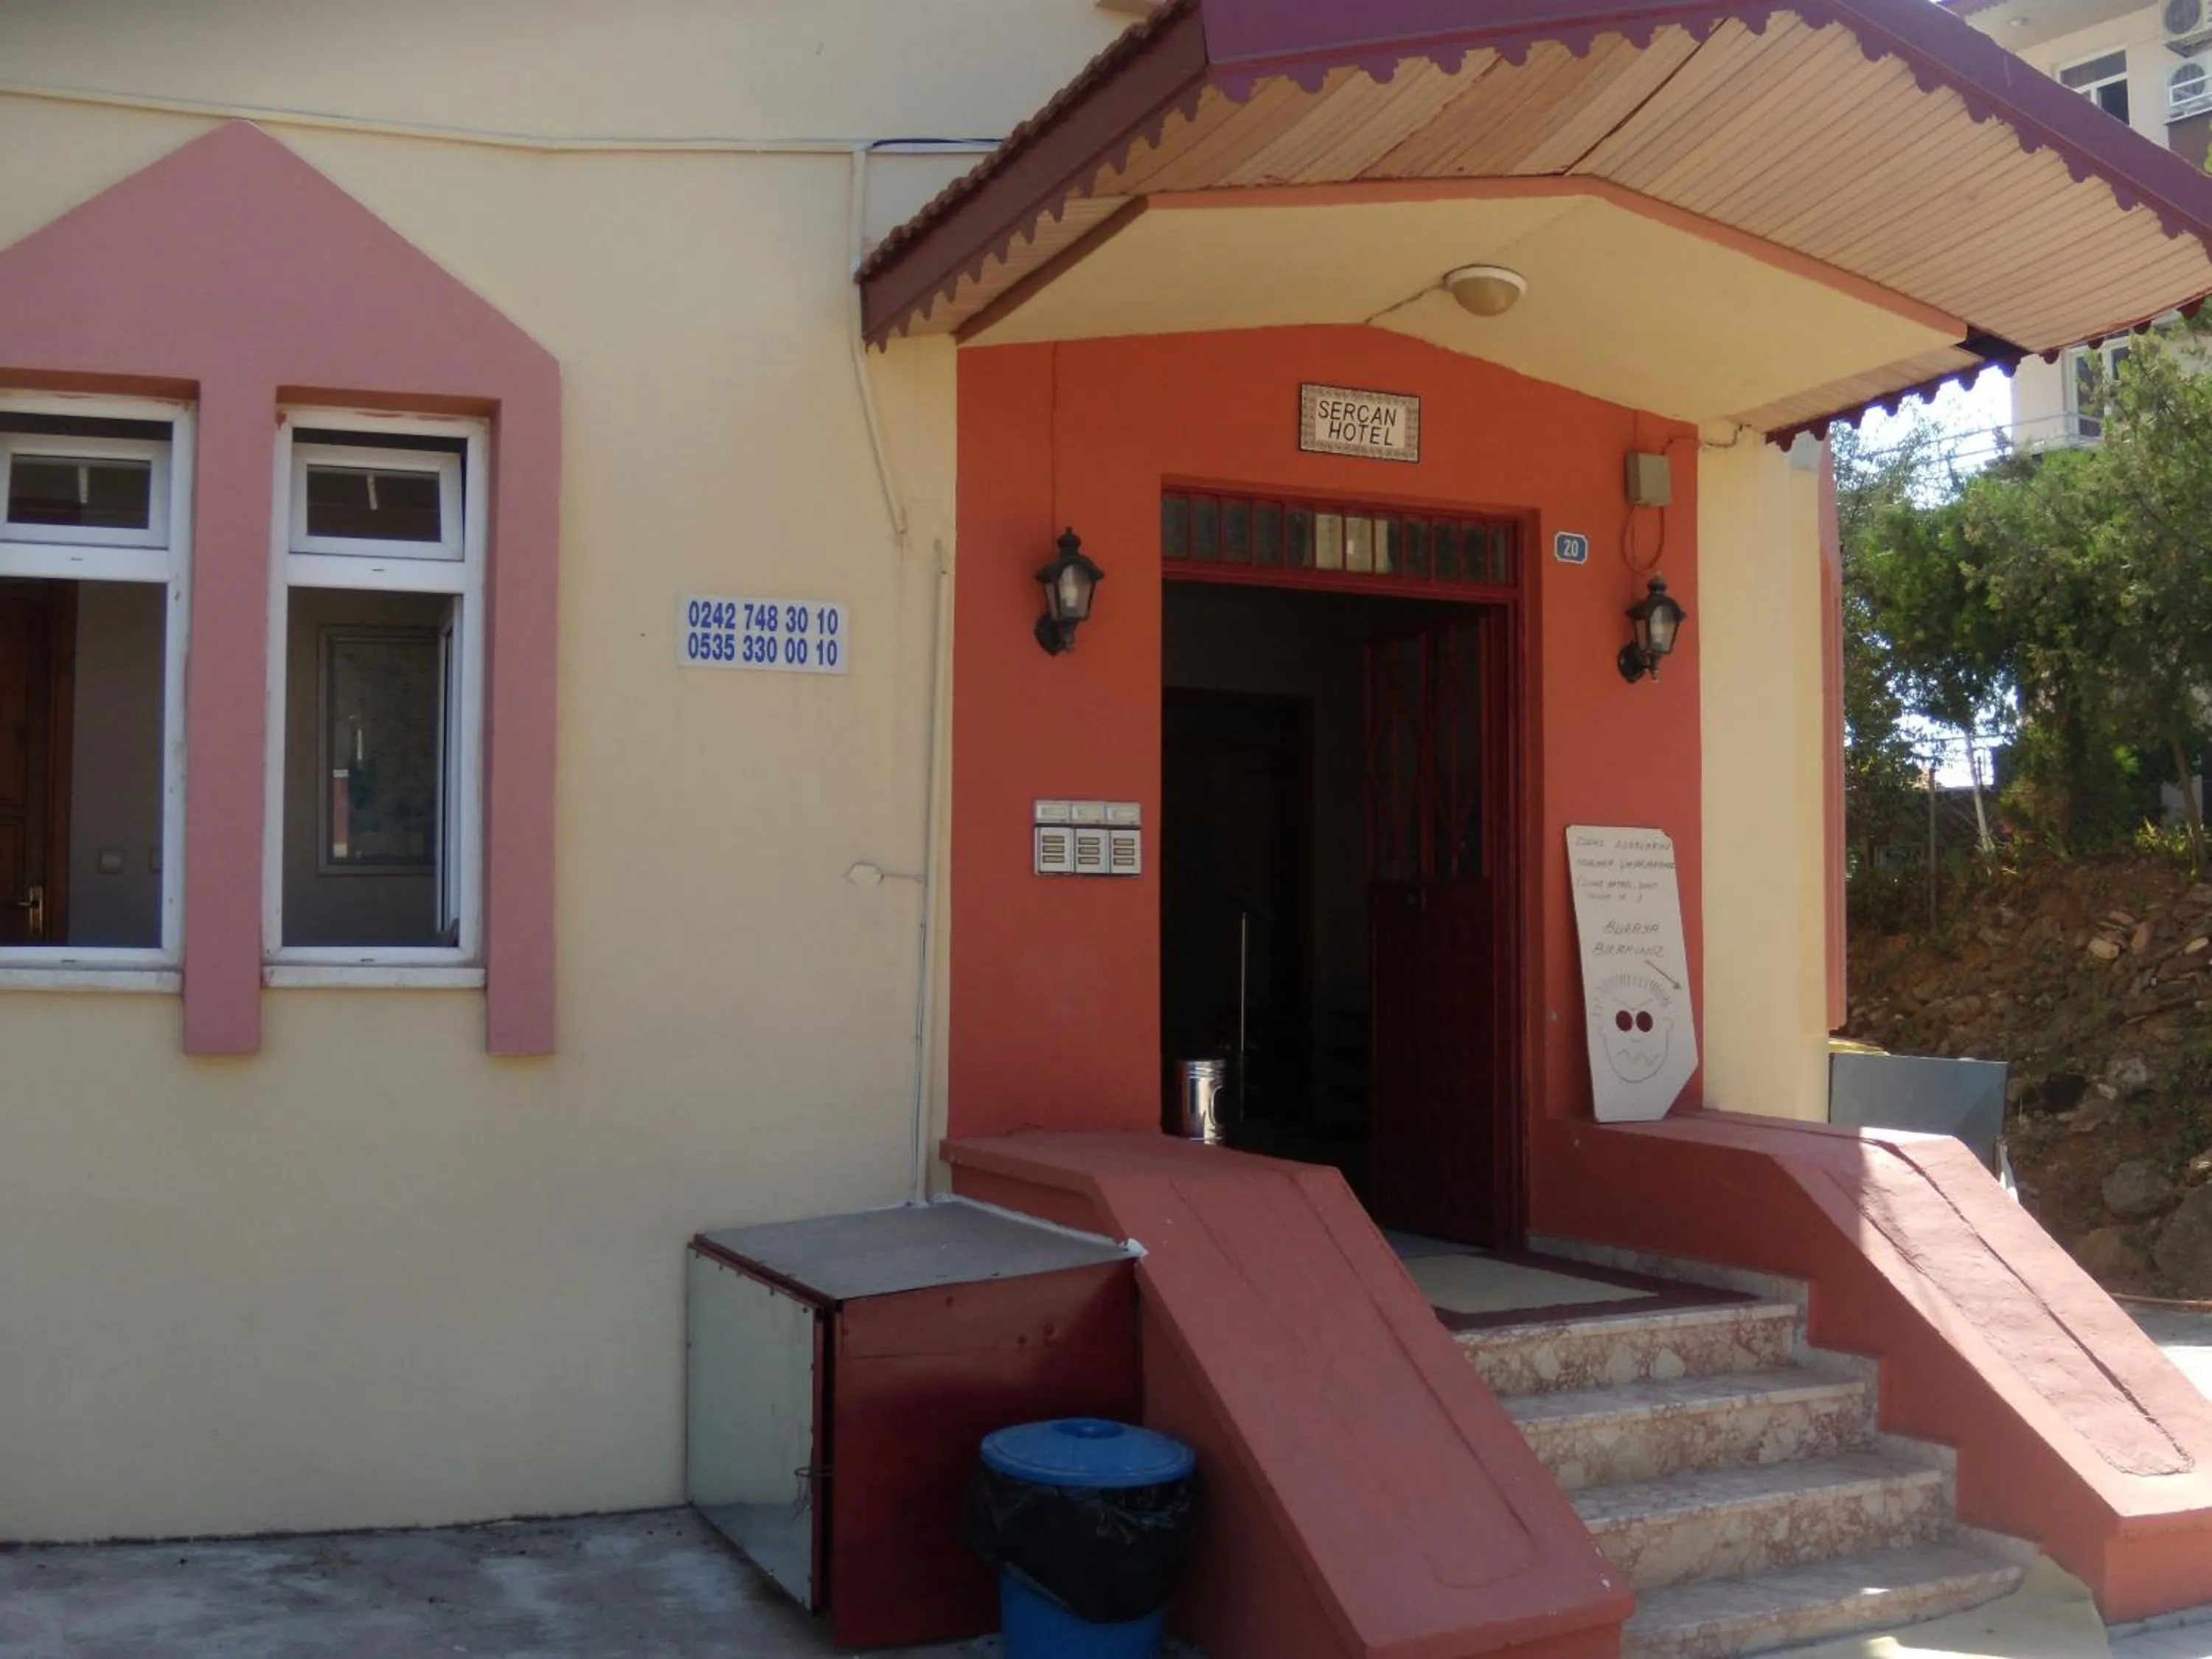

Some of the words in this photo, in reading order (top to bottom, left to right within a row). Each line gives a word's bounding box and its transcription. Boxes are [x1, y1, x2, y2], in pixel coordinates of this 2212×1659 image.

[1318, 400, 1397, 427] SERCAN
[1328, 421, 1393, 446] HOTEL
[1563, 539, 1579, 557] 20
[688, 600, 736, 628] 0242
[744, 603, 778, 632] 748
[785, 605, 808, 633] 30
[817, 608, 838, 635] 10
[688, 632, 735, 661] 0535
[742, 635, 777, 664] 330
[785, 637, 807, 664] 00
[816, 639, 838, 667] 10
